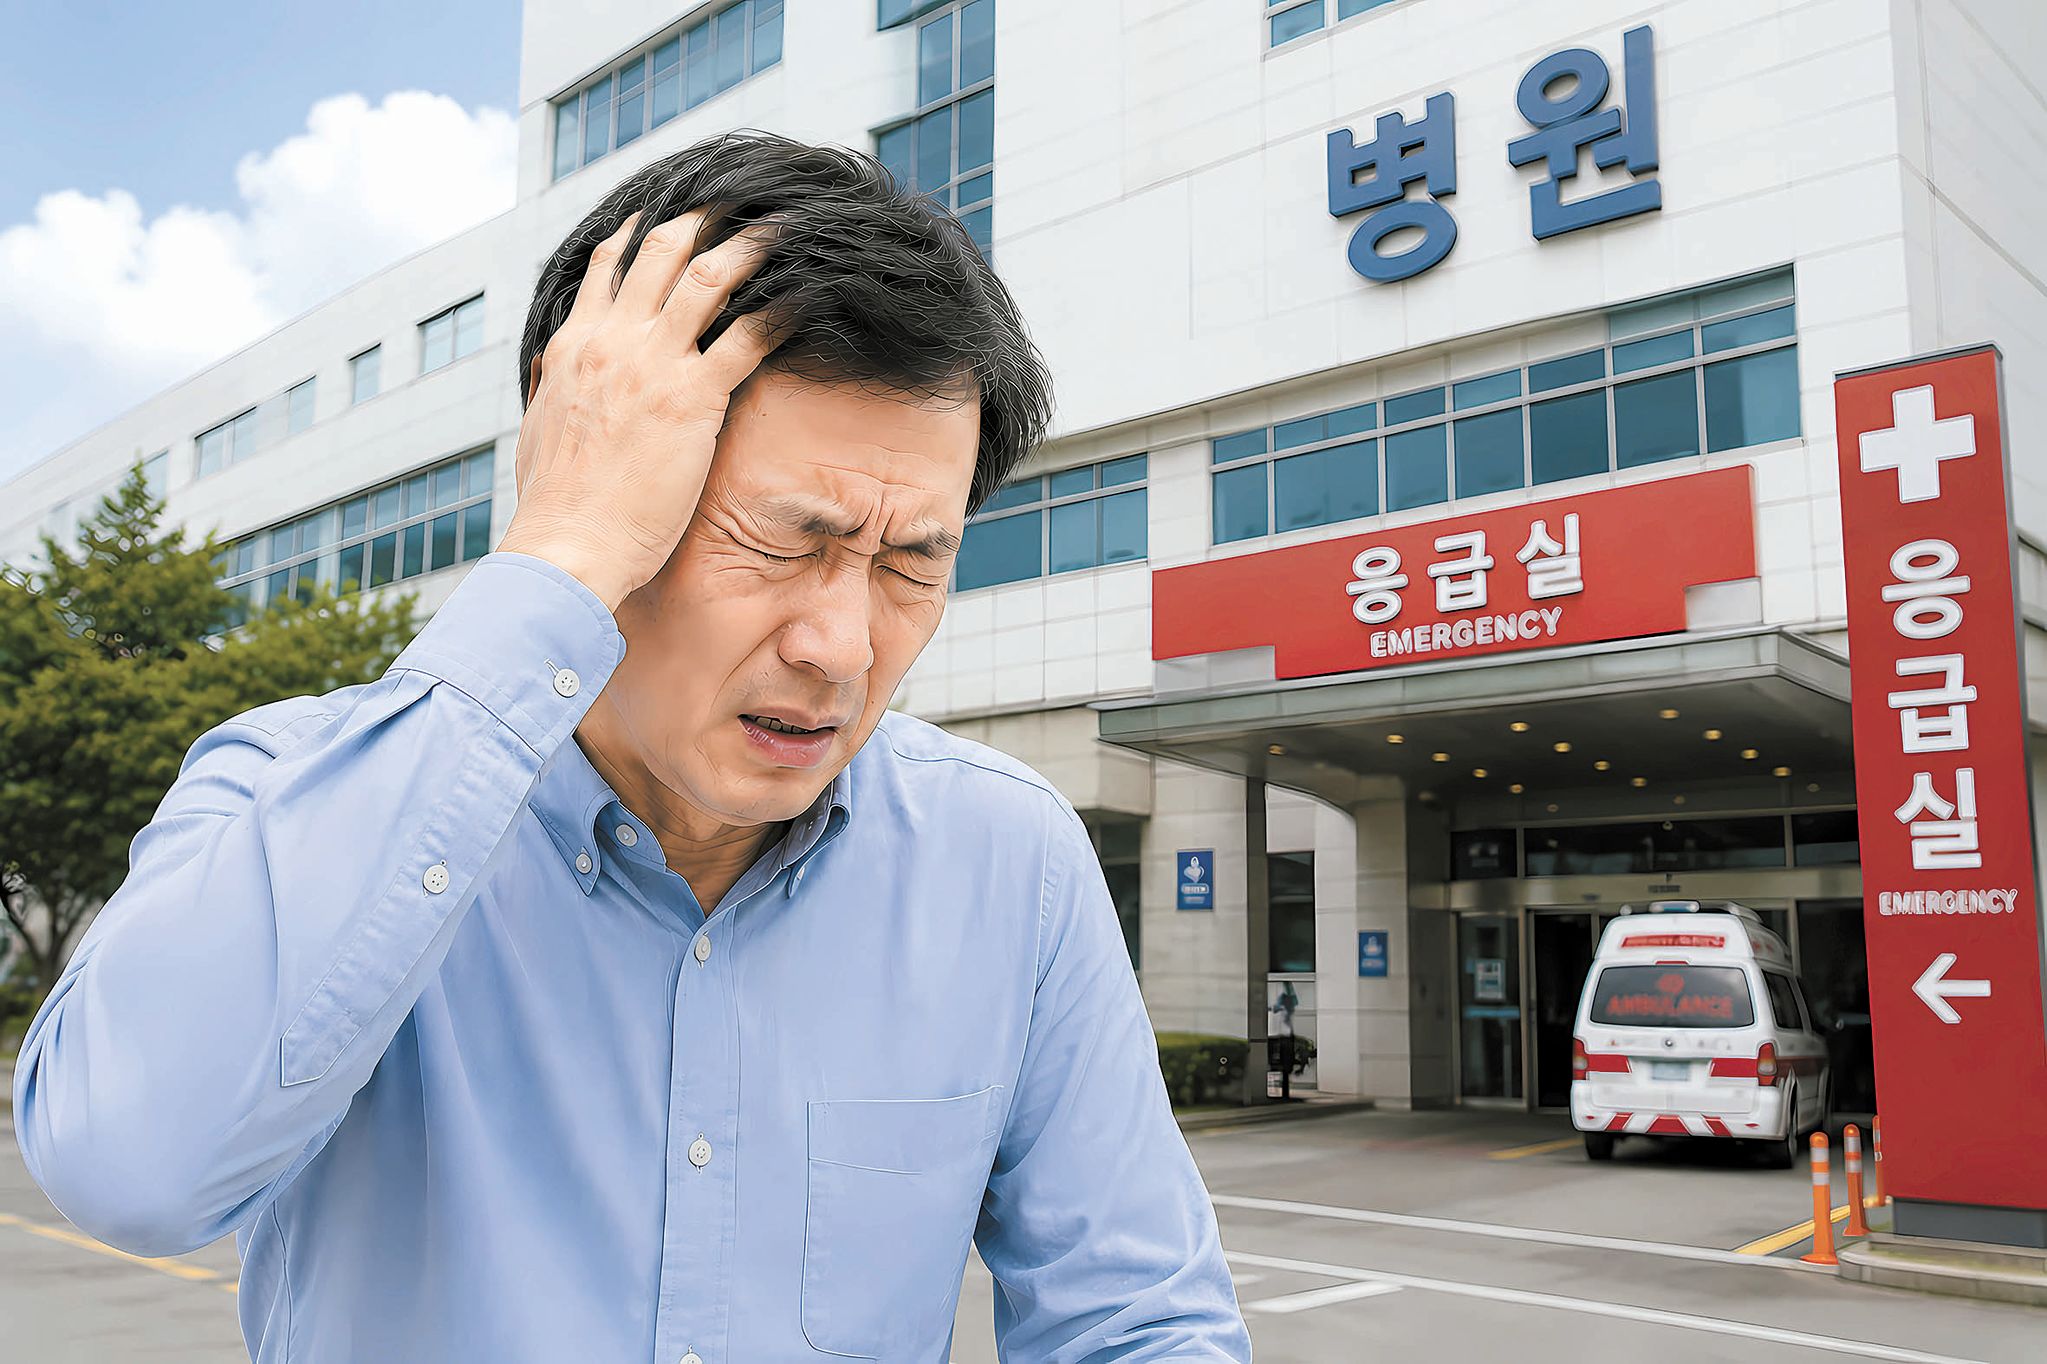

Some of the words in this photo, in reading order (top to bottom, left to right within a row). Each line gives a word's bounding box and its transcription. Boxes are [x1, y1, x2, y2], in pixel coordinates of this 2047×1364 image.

[1327, 25, 1662, 282] 병원
[1346, 512, 1584, 625] 응급실
[1370, 606, 1563, 658] EMERGENCY
[1881, 539, 1983, 870] 응급실
[1606, 994, 1734, 1019] AMBULANCE
